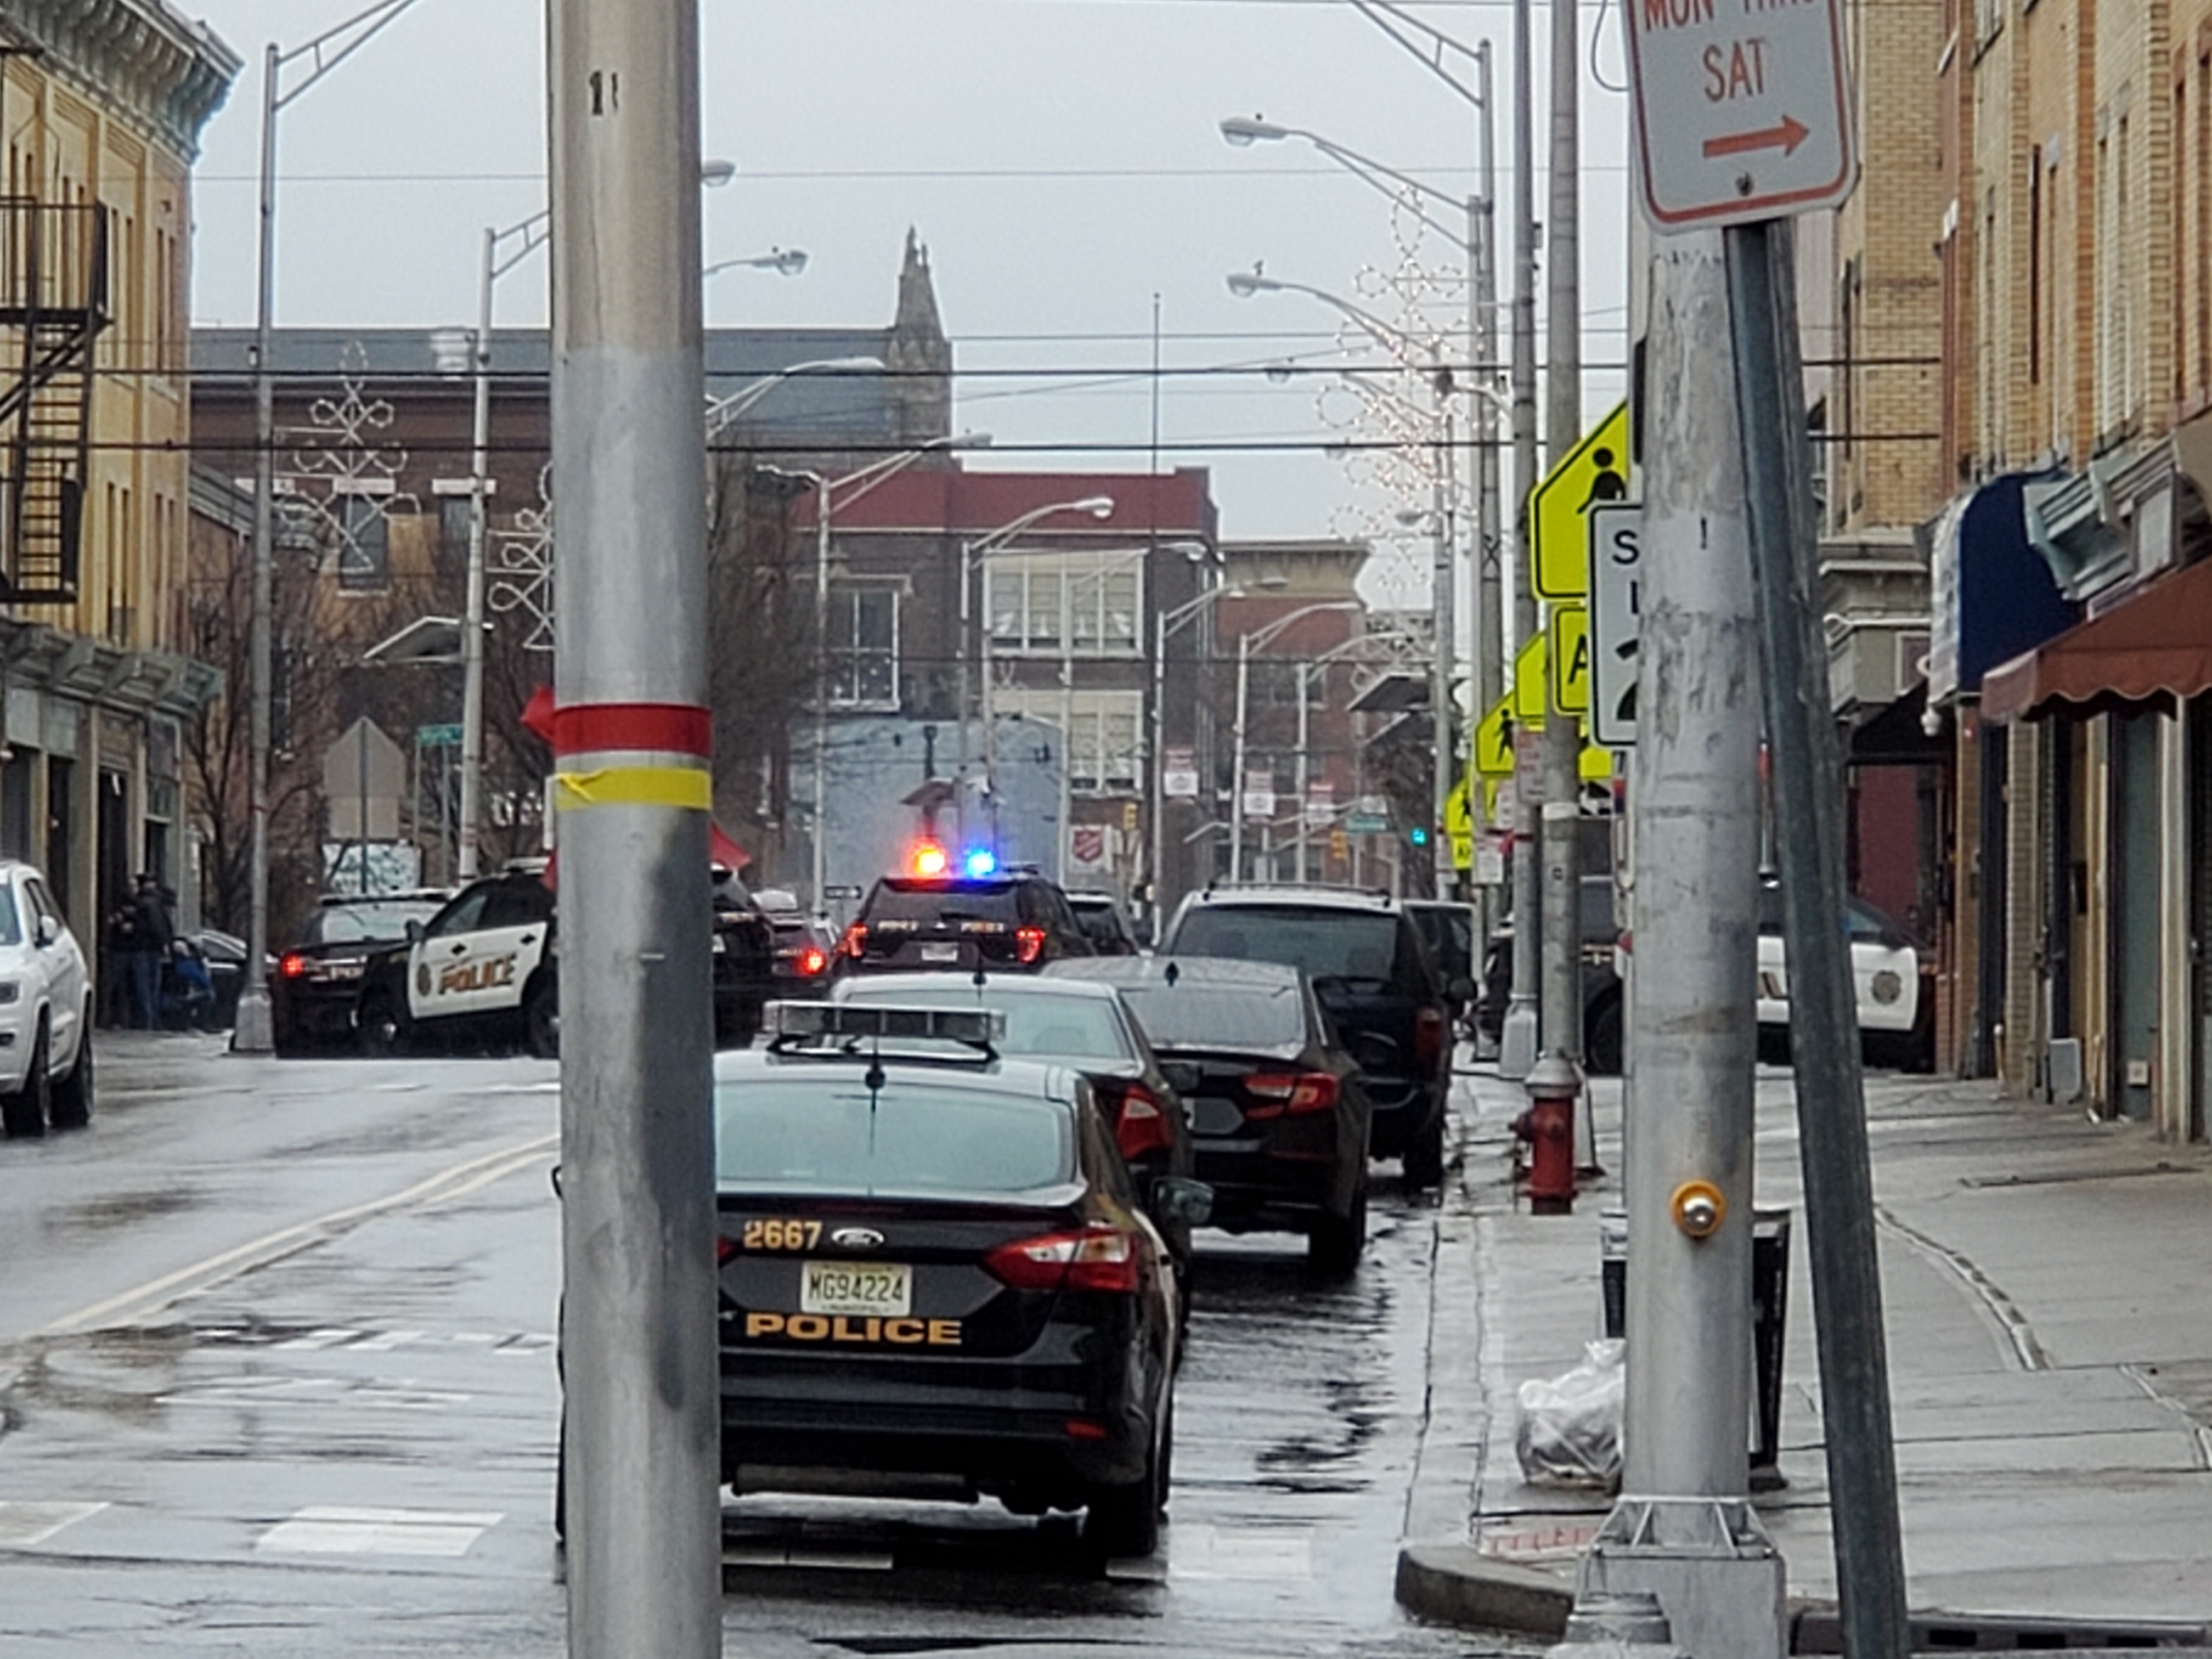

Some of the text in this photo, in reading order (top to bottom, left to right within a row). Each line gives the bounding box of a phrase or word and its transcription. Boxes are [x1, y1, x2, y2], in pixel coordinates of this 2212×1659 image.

[1703, 37, 1765, 103] SAT
[438, 952, 517, 996] POLICE
[743, 1220, 822, 1250] 2667
[746, 1313, 962, 1345] POLICE
